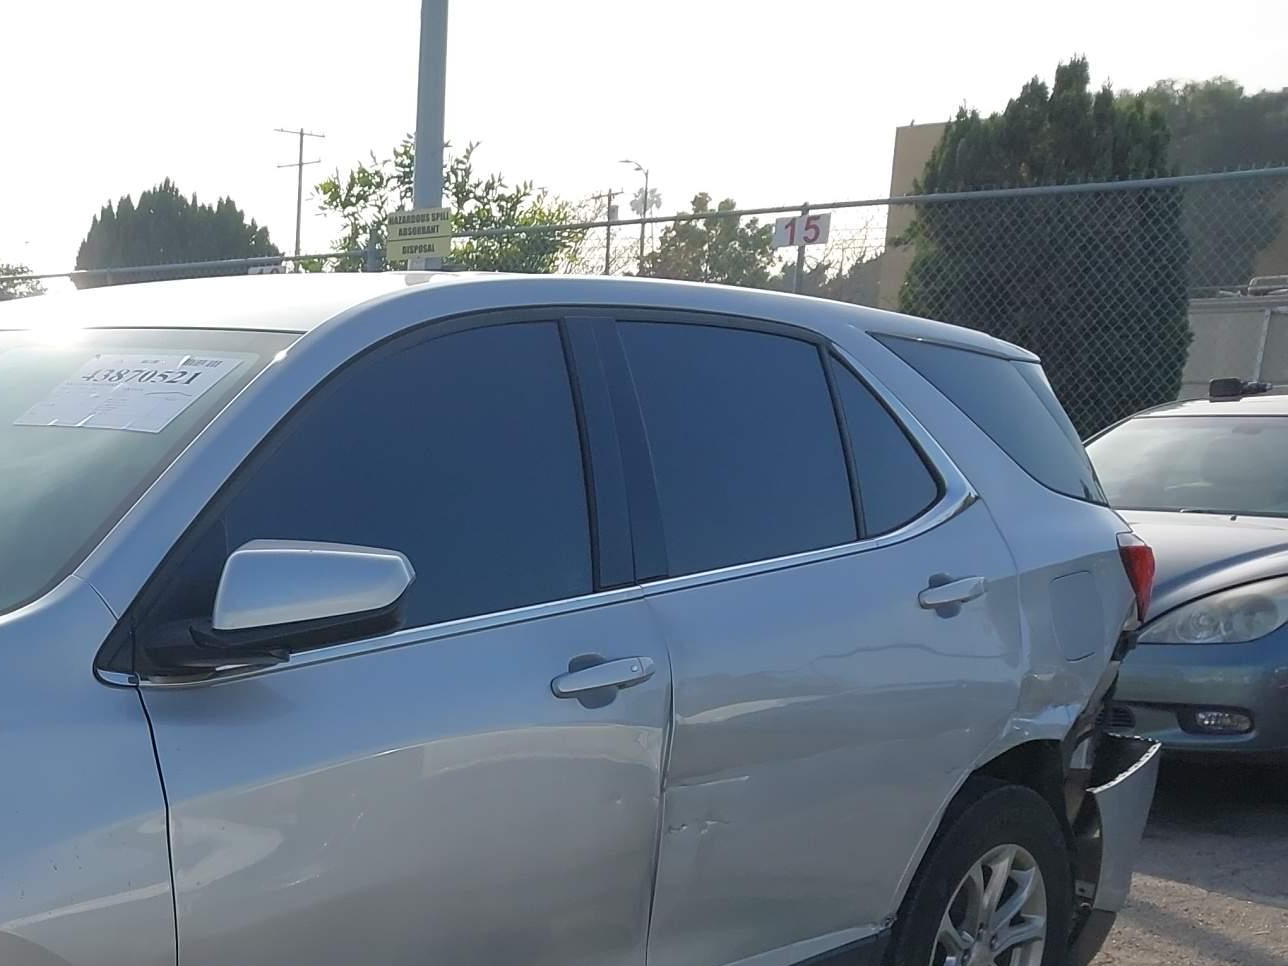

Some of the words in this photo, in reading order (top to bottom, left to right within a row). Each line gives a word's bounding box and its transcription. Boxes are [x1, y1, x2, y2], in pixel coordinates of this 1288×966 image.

[388, 213, 430, 225] HAZARDOUS
[784, 214, 821, 246] 15
[402, 244, 435, 255] DISPOSAL
[81, 368, 203, 385] 43870521
